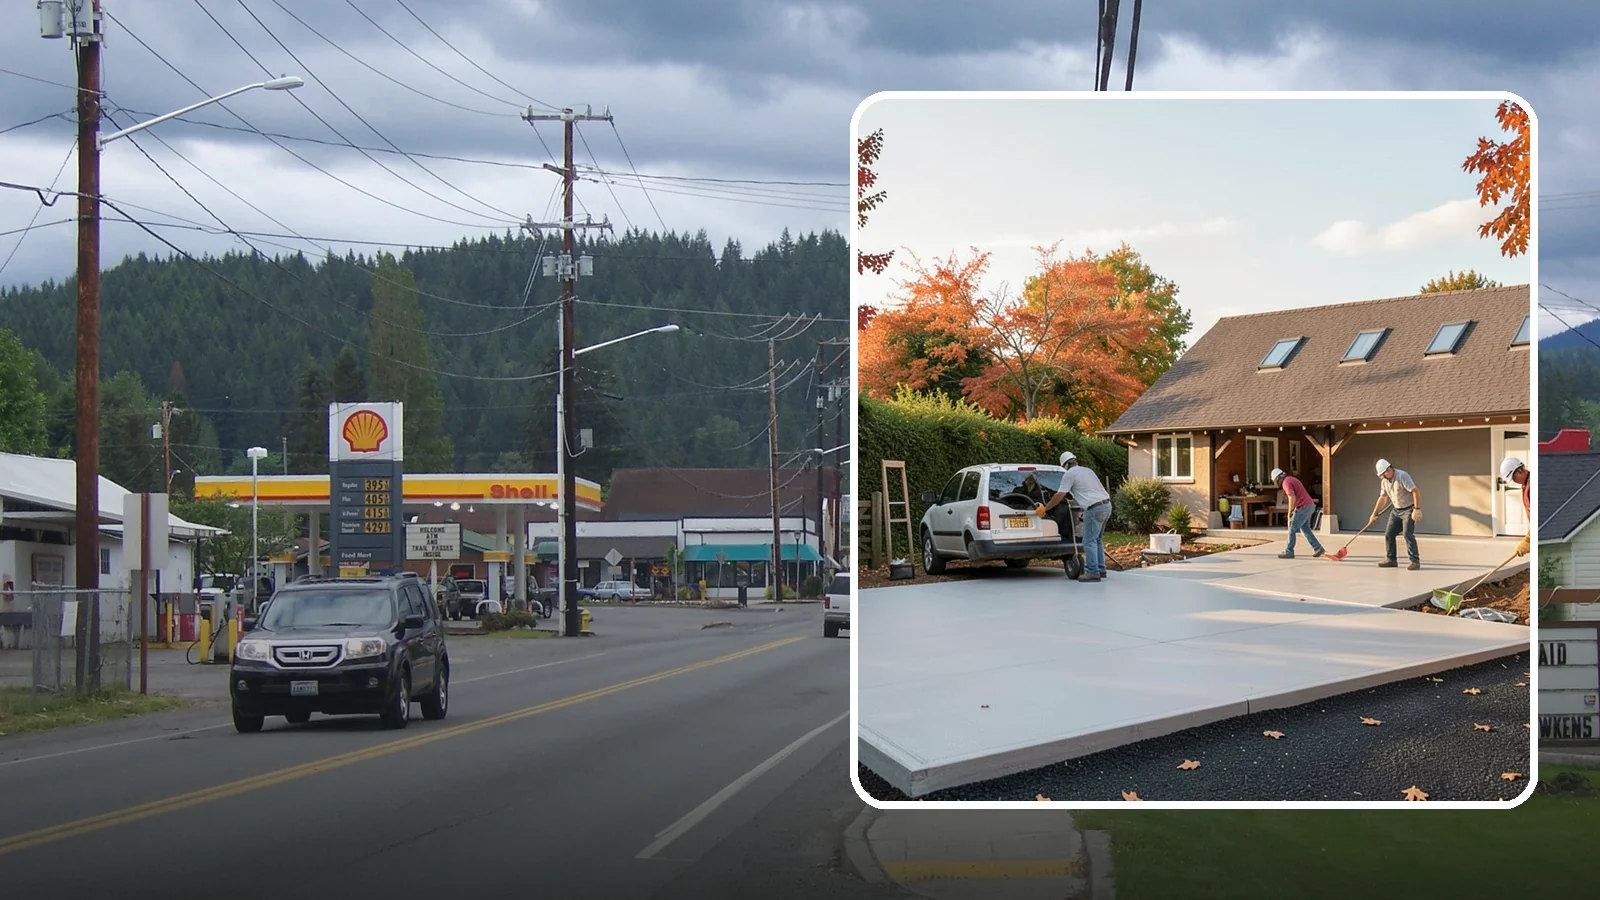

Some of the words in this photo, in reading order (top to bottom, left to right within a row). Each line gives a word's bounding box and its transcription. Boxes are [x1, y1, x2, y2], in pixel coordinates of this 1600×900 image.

[365, 480, 384, 490] 395
[489, 484, 547, 499] Shell
[365, 494, 384, 504] 405
[365, 508, 384, 518] 415
[365, 522, 384, 532] 429
